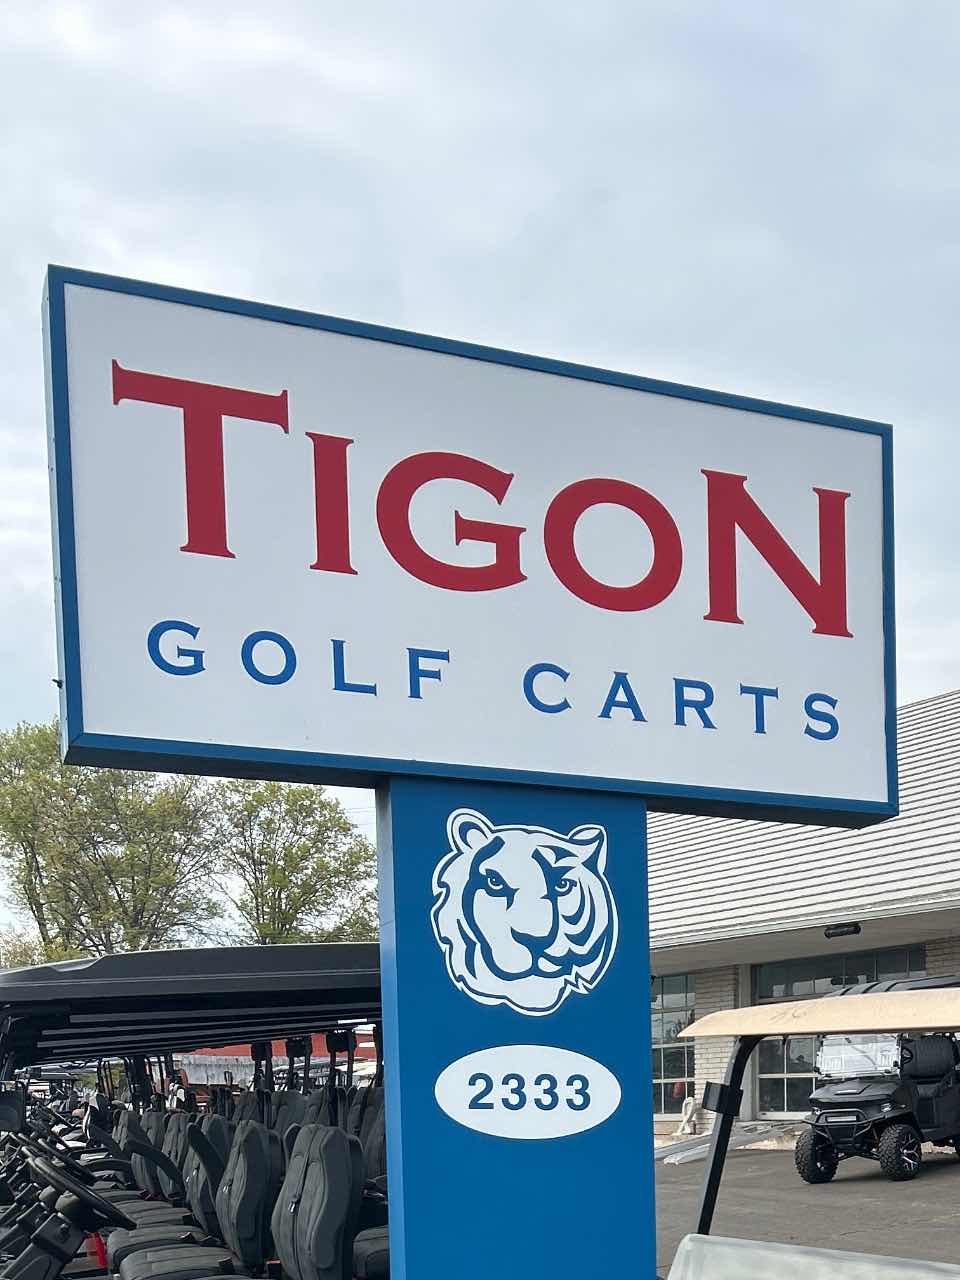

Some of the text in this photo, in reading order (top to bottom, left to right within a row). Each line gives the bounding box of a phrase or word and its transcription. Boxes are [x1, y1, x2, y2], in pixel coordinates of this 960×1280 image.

[112, 359, 854, 638] TIGON
[147, 620, 840, 741] GOLF CARTS
[468, 1072, 591, 1111] 2333
